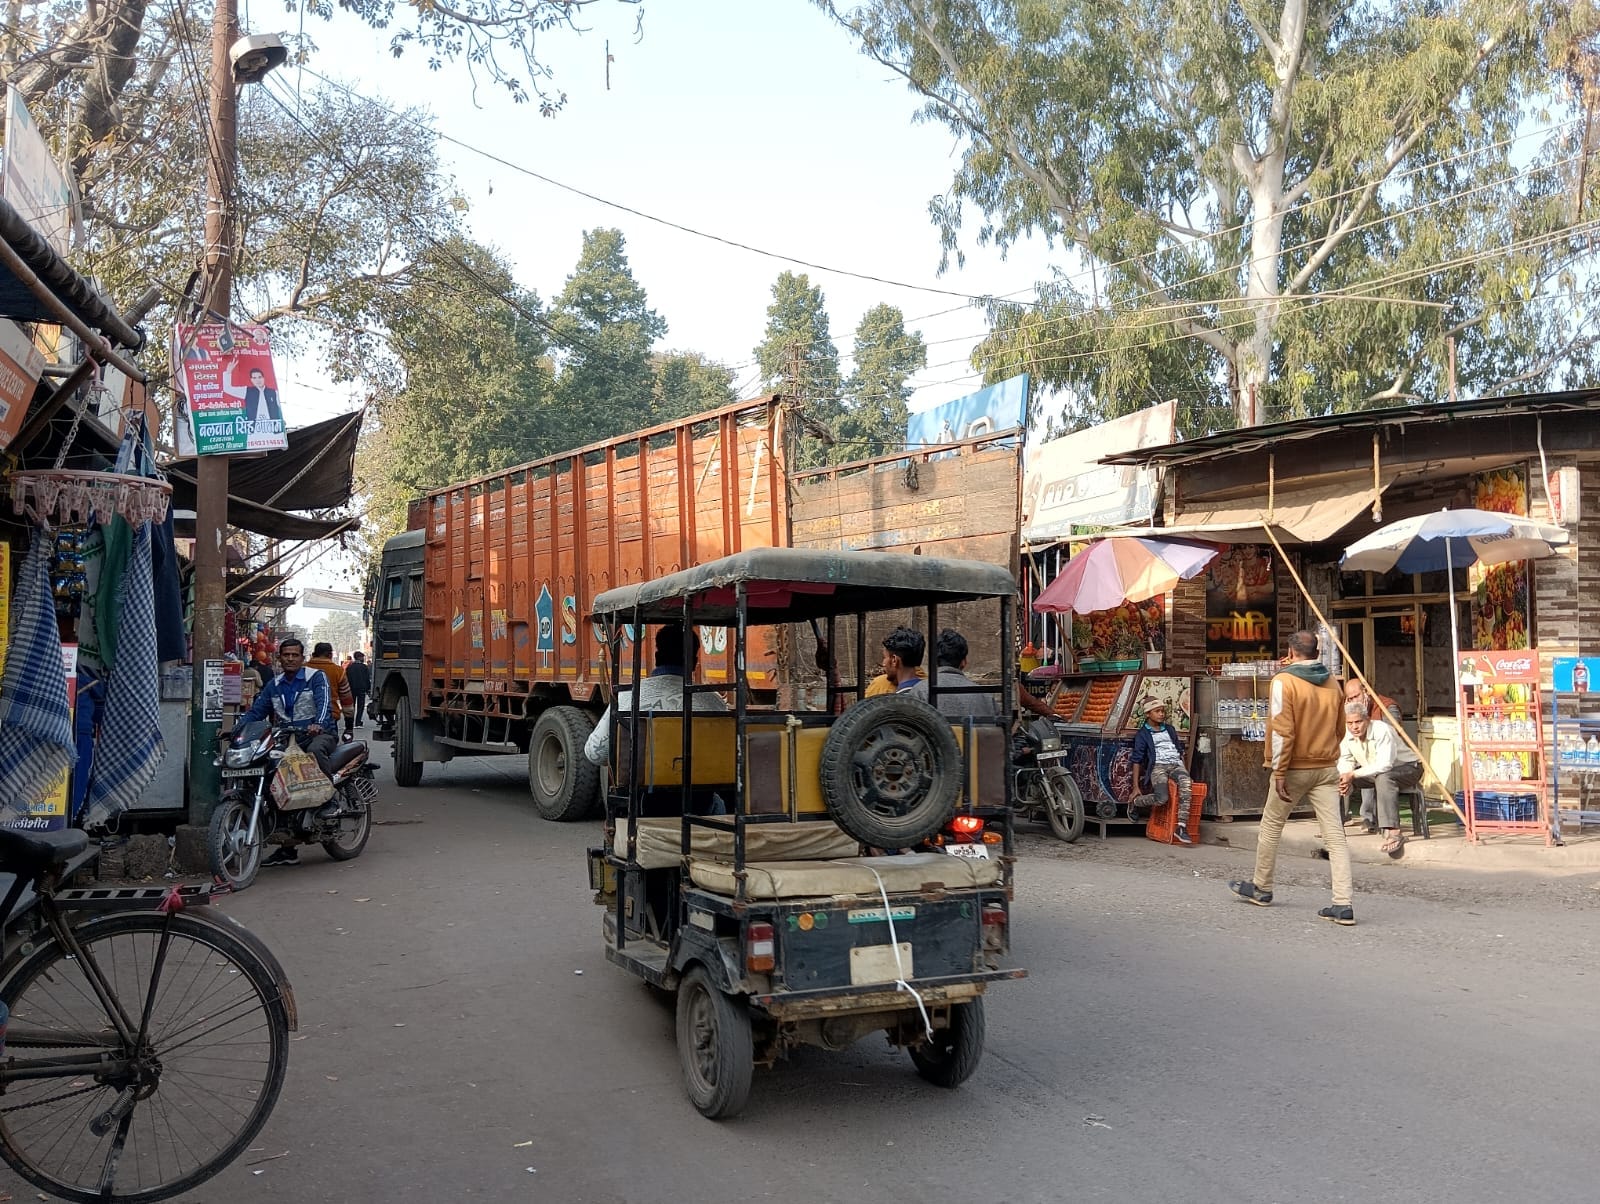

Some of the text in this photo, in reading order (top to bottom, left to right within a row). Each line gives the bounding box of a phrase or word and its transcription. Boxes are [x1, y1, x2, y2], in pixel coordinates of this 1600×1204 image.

[199, 422, 233, 437] बलवान
[235, 416, 254, 436] सिंह
[1207, 611, 1271, 641] ज्योति
